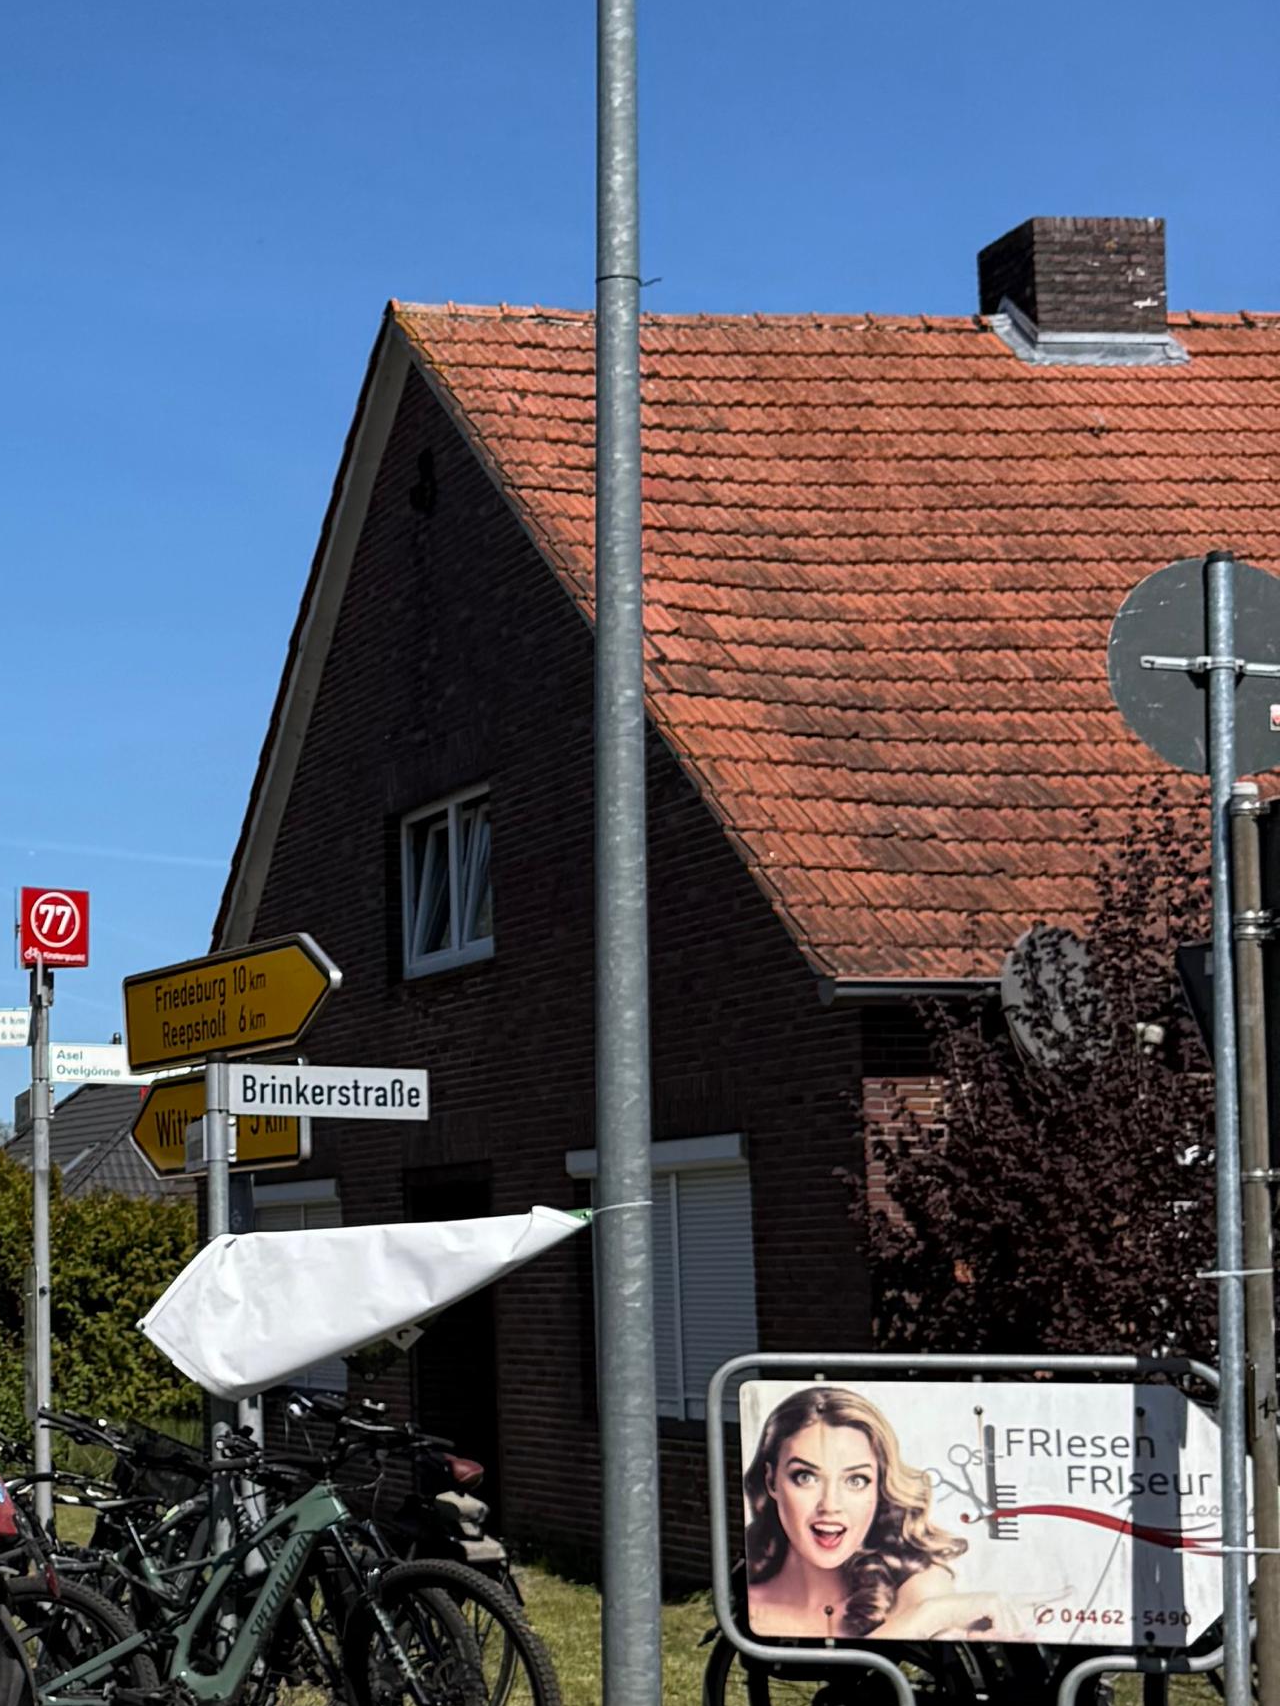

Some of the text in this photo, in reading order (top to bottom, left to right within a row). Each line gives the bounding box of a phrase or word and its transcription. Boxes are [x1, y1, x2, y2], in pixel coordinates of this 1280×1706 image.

[39, 904, 72, 935] 77
[155, 965, 267, 1013] Friedeburg 10 km
[9, 1016, 26, 1025] km
[162, 1005, 267, 1049] Reepsholt 6 km
[9, 1030, 26, 1039] km
[56, 1049, 82, 1061] Asel
[56, 1063, 121, 1078] Ovelgönne
[242, 1074, 421, 1107] Brinkerstraße
[1067, 1464, 1213, 1496] FRIseur
[1060, 1608, 1125, 1625] 04462
[1142, 1609, 1192, 1627] 5490
